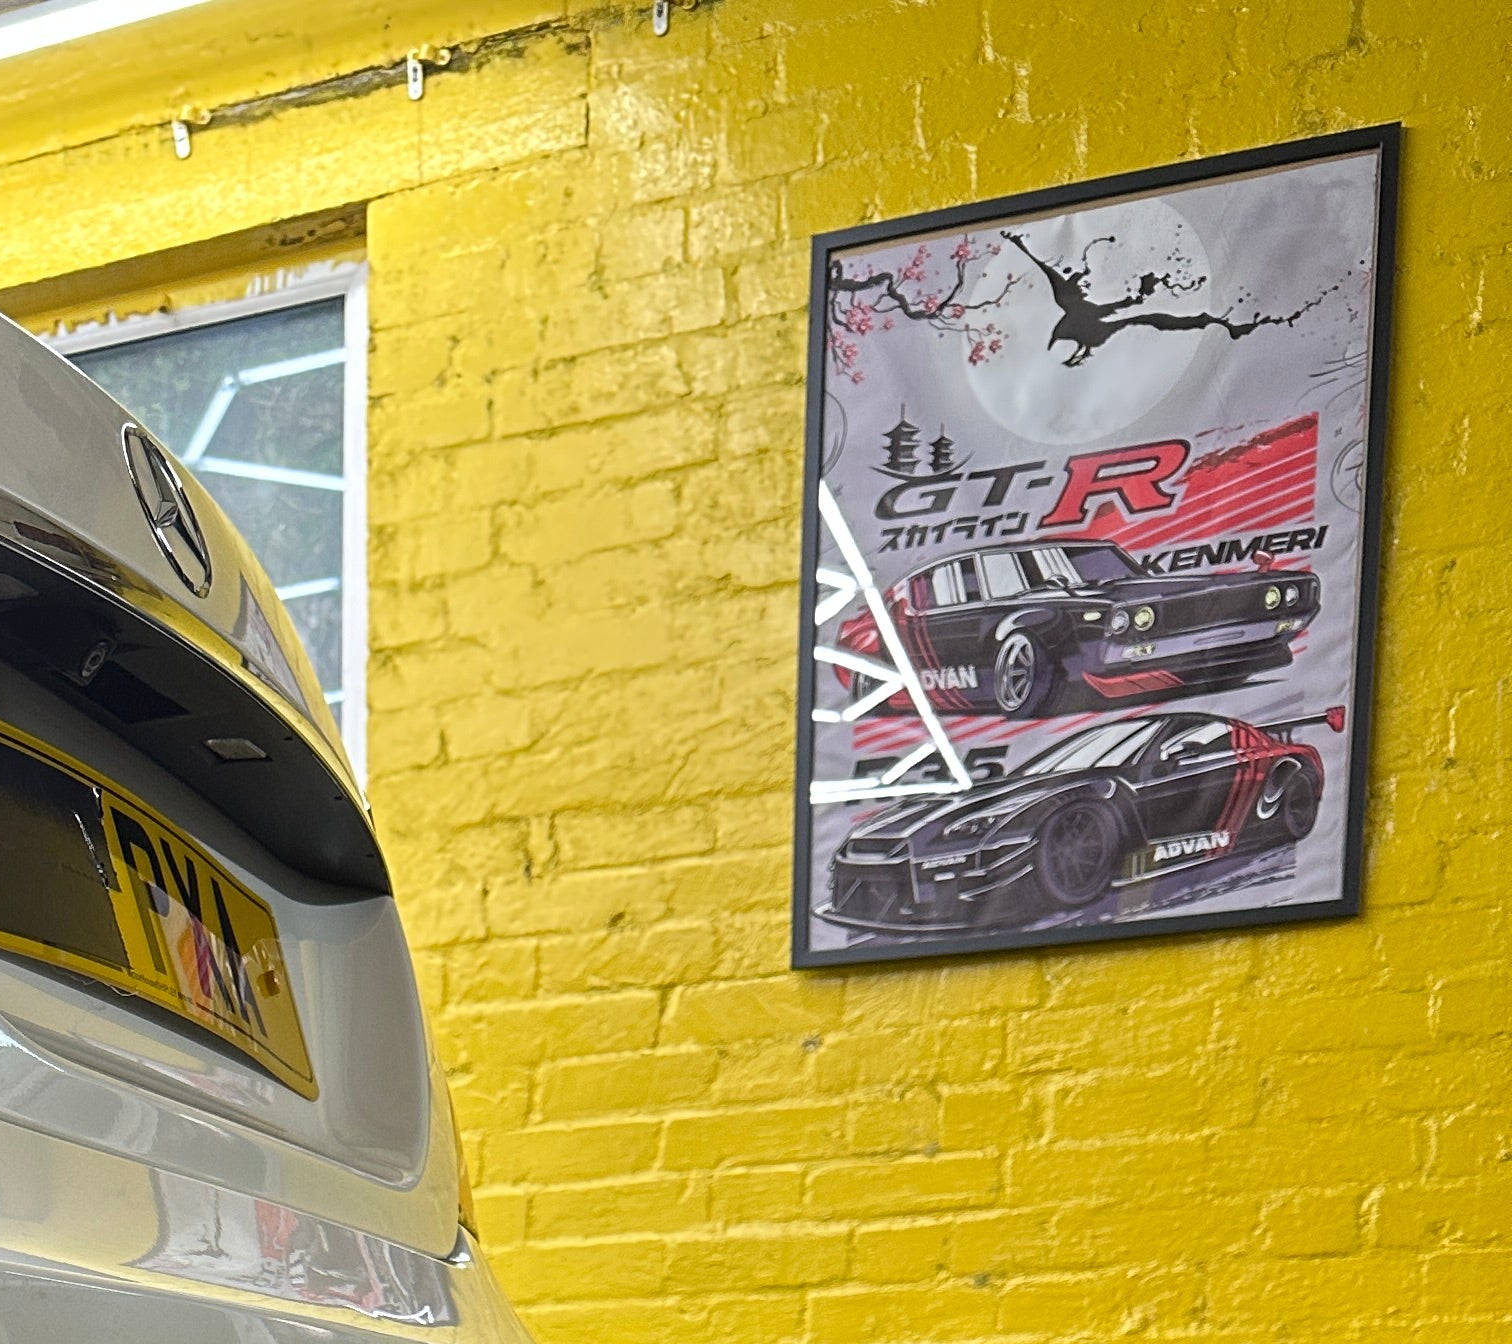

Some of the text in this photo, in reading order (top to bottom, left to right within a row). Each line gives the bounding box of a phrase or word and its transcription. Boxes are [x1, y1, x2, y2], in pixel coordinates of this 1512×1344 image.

[875, 438, 1190, 531] GT-R
[878, 510, 1030, 554] スカイライン
[1140, 525, 1328, 575] KENMERI
[910, 664, 978, 690] DVAN
[1152, 831, 1231, 863] ADVAN
